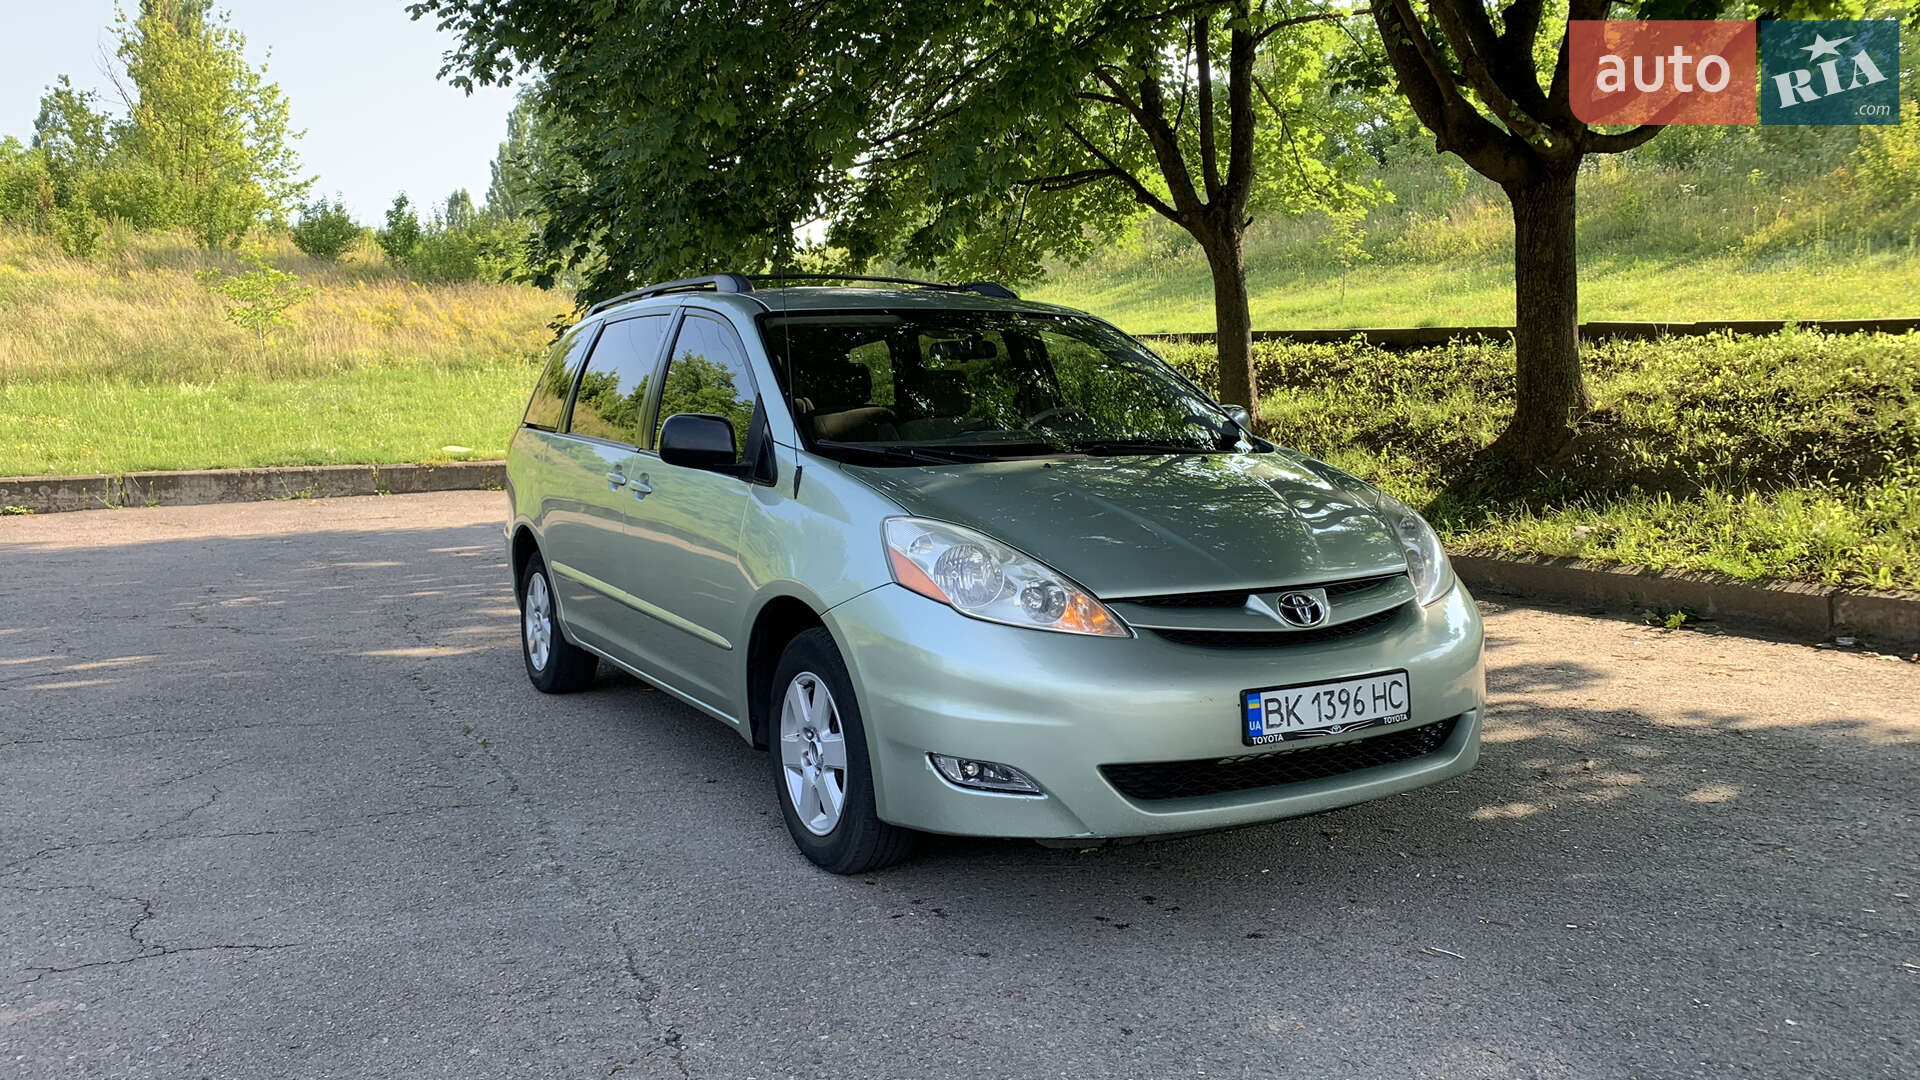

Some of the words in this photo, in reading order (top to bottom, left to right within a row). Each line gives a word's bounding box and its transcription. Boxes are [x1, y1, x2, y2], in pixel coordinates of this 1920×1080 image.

[1264, 694, 1304, 729] BK
[1311, 686, 1366, 722] 1396
[1372, 680, 1404, 713] HC
[1383, 713, 1408, 724] TOYOTA
[1249, 720, 1262, 731] UA
[1252, 733, 1284, 745] TOYOTA
